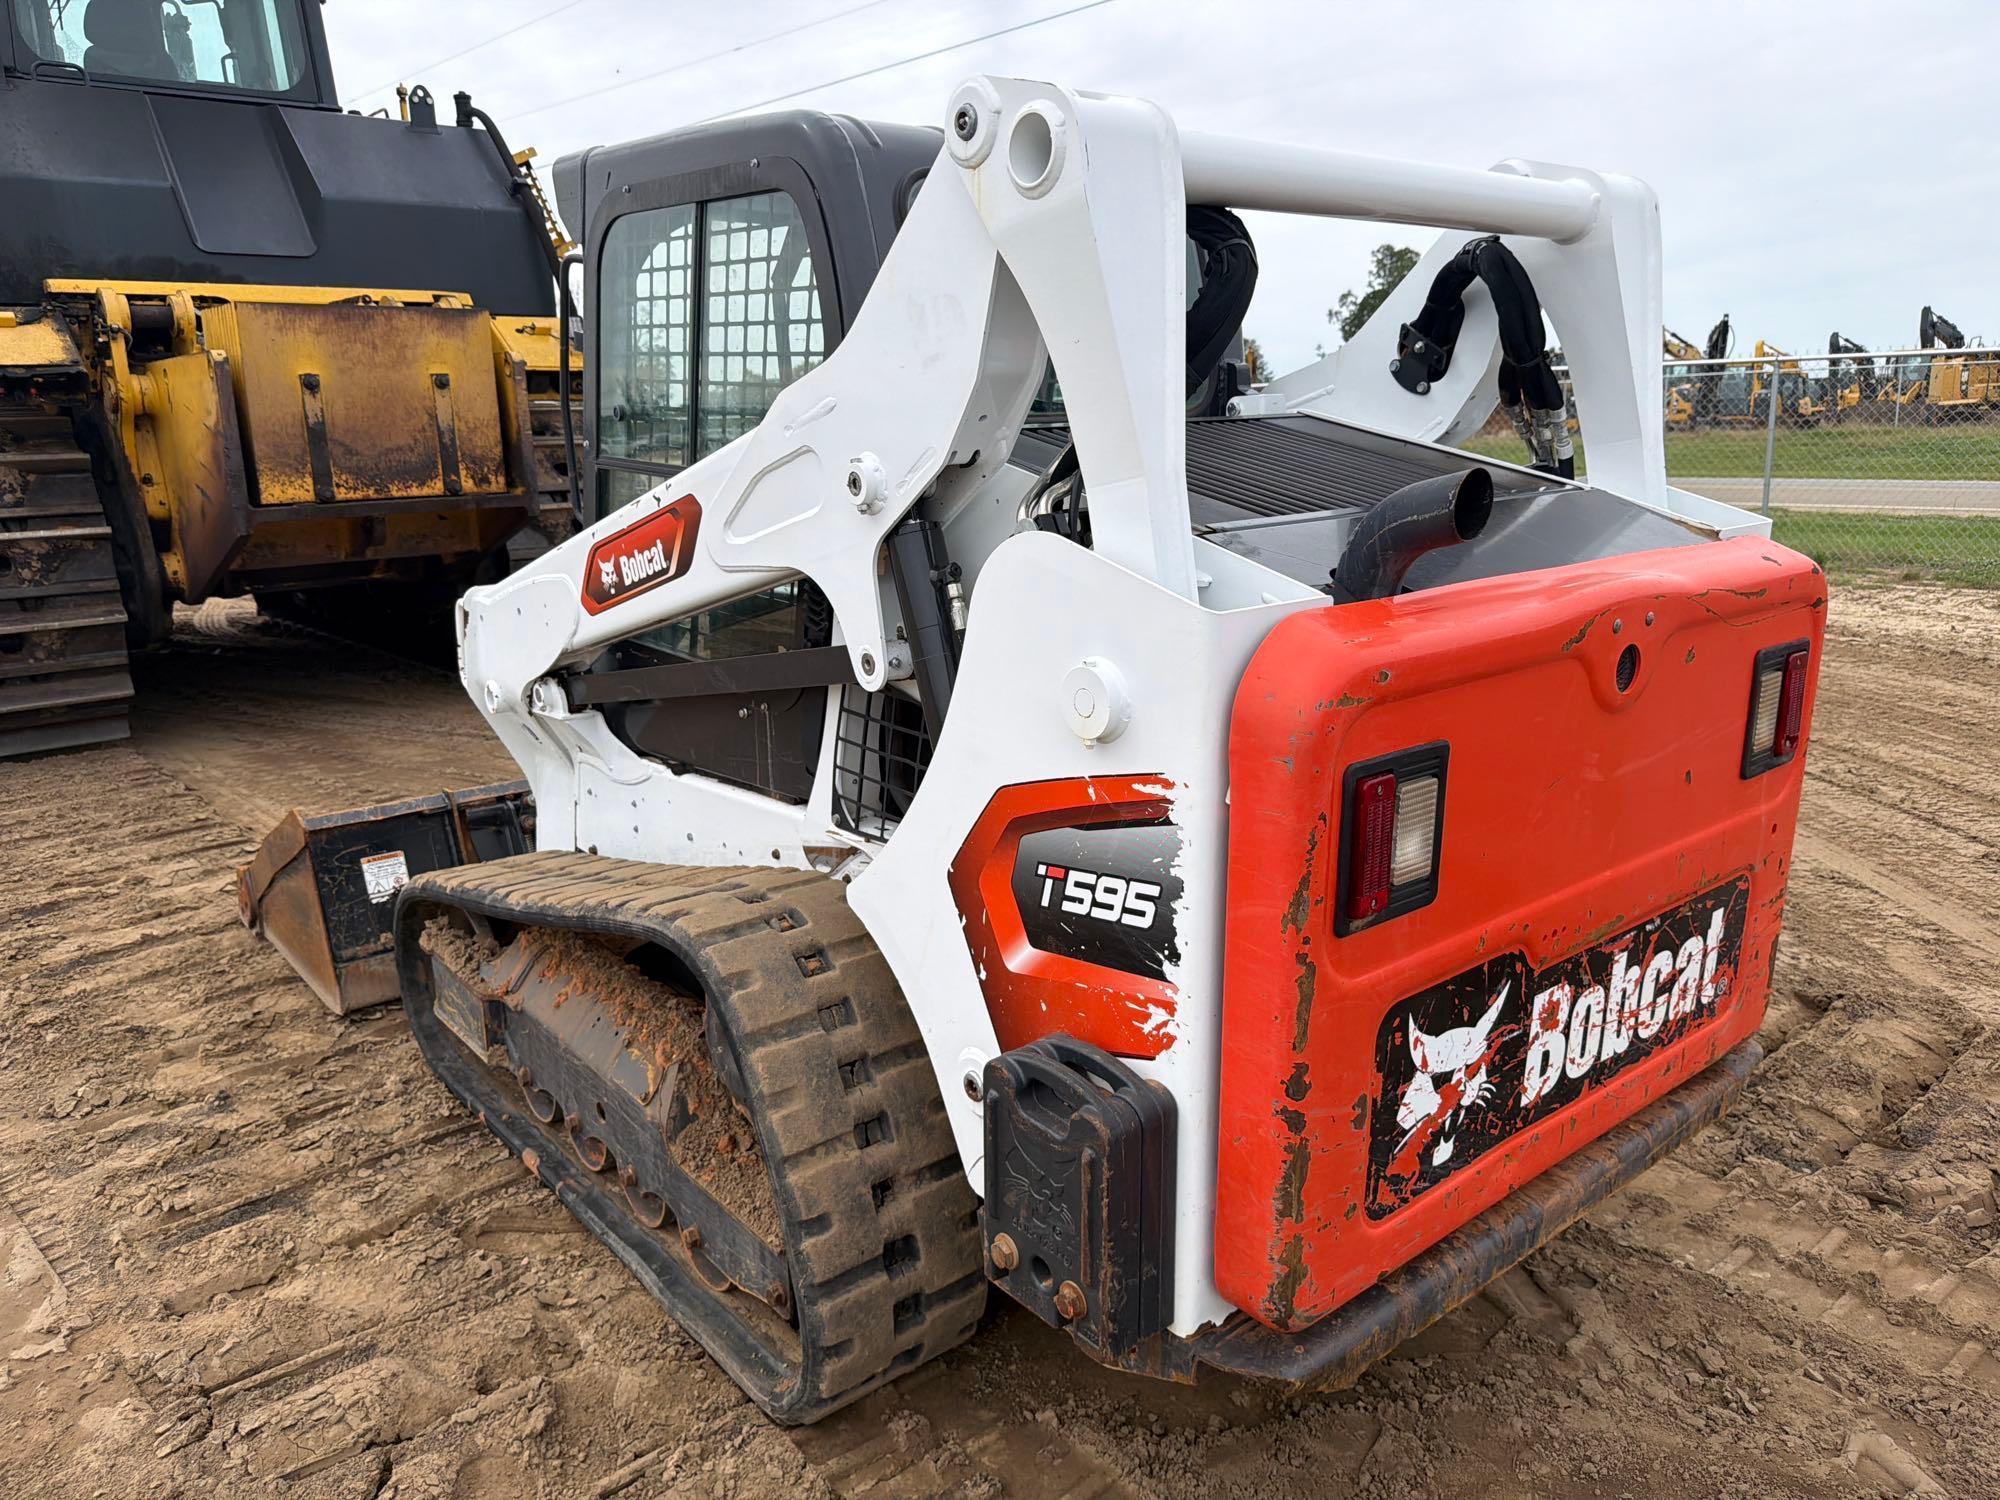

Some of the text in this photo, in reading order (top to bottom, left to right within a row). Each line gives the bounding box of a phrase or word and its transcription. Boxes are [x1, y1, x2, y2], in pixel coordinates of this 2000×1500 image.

[619, 538, 668, 587] Bobcat
[1037, 863, 1162, 930] T595
[1519, 906, 1726, 1108] Bobcat
